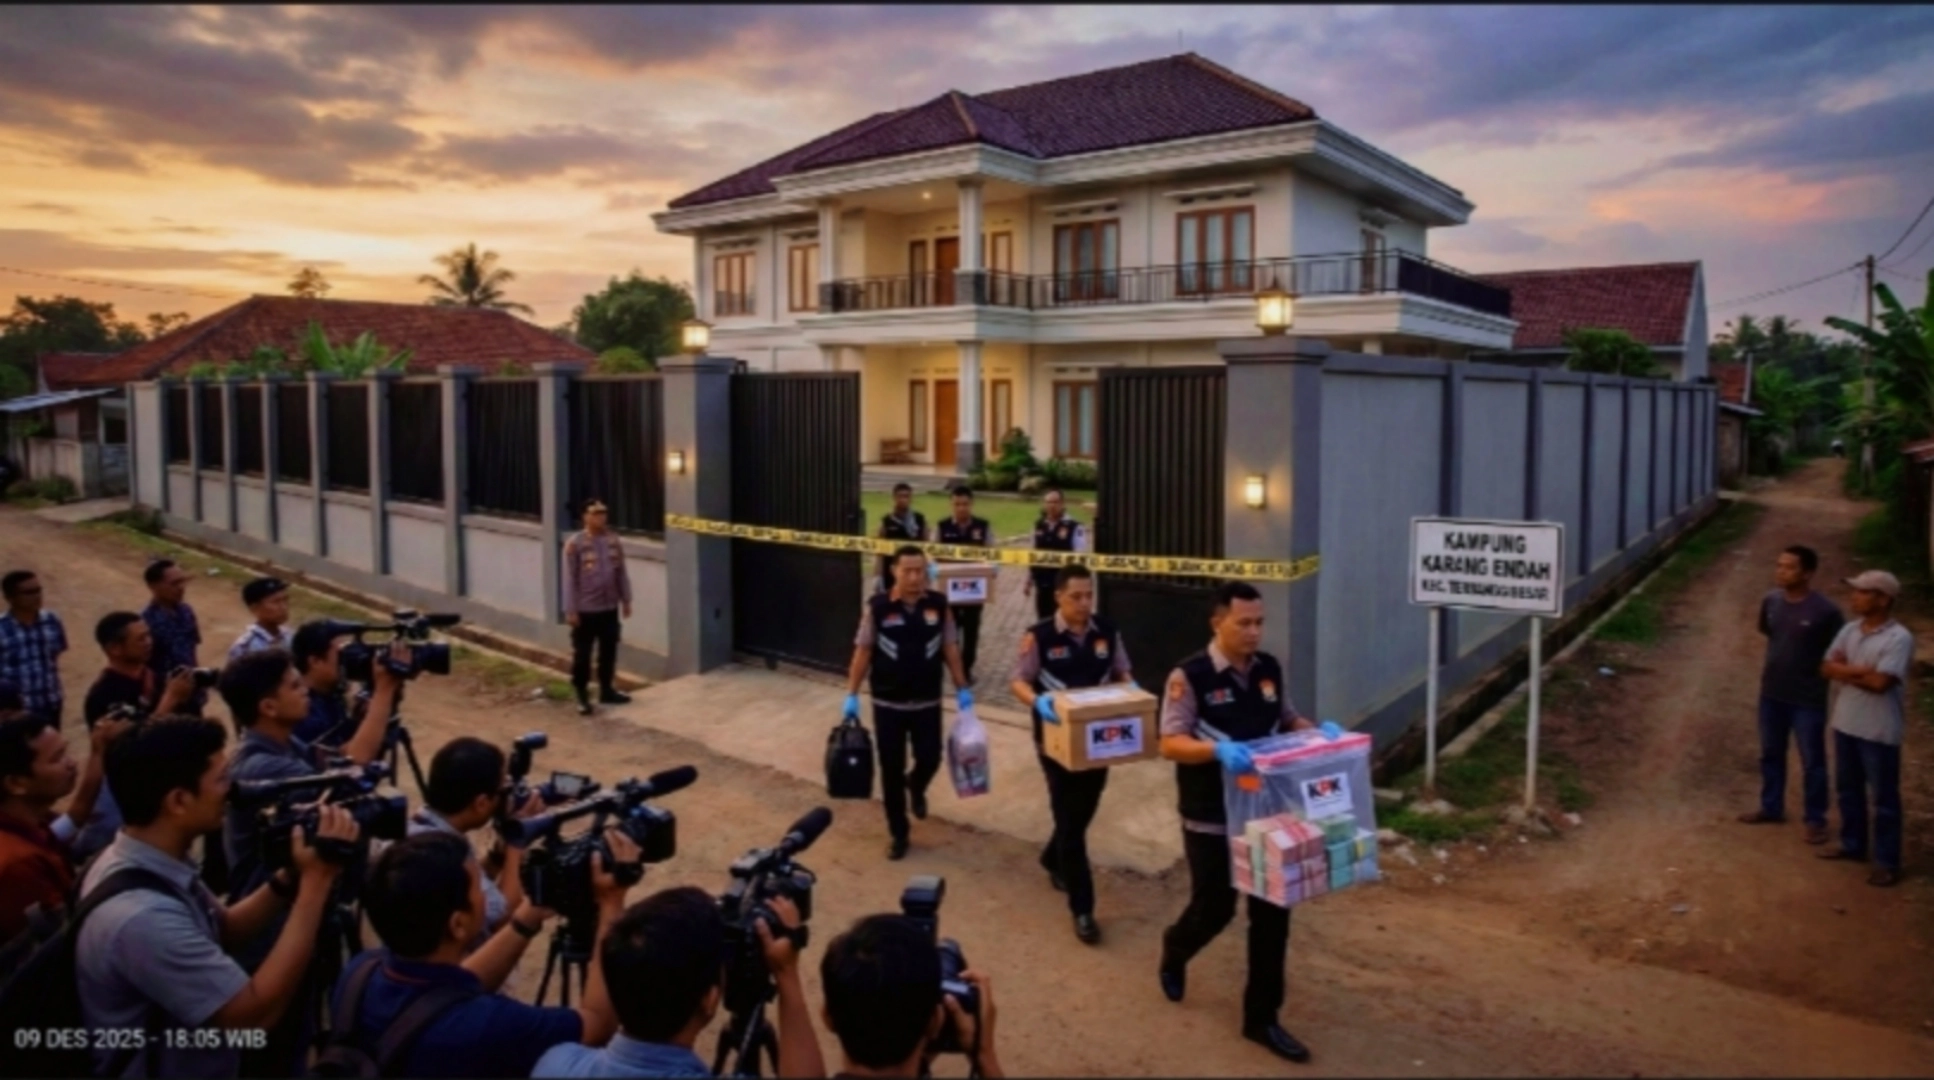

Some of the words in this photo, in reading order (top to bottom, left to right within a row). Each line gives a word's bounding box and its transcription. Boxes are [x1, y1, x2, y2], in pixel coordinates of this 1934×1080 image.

[1444, 532, 1526, 554] KAMPUNG
[1421, 556, 1488, 576] KARANG
[1493, 560, 1550, 580] ENDAH
[1092, 724, 1136, 744] KPK
[1307, 777, 1341, 799] KPK
